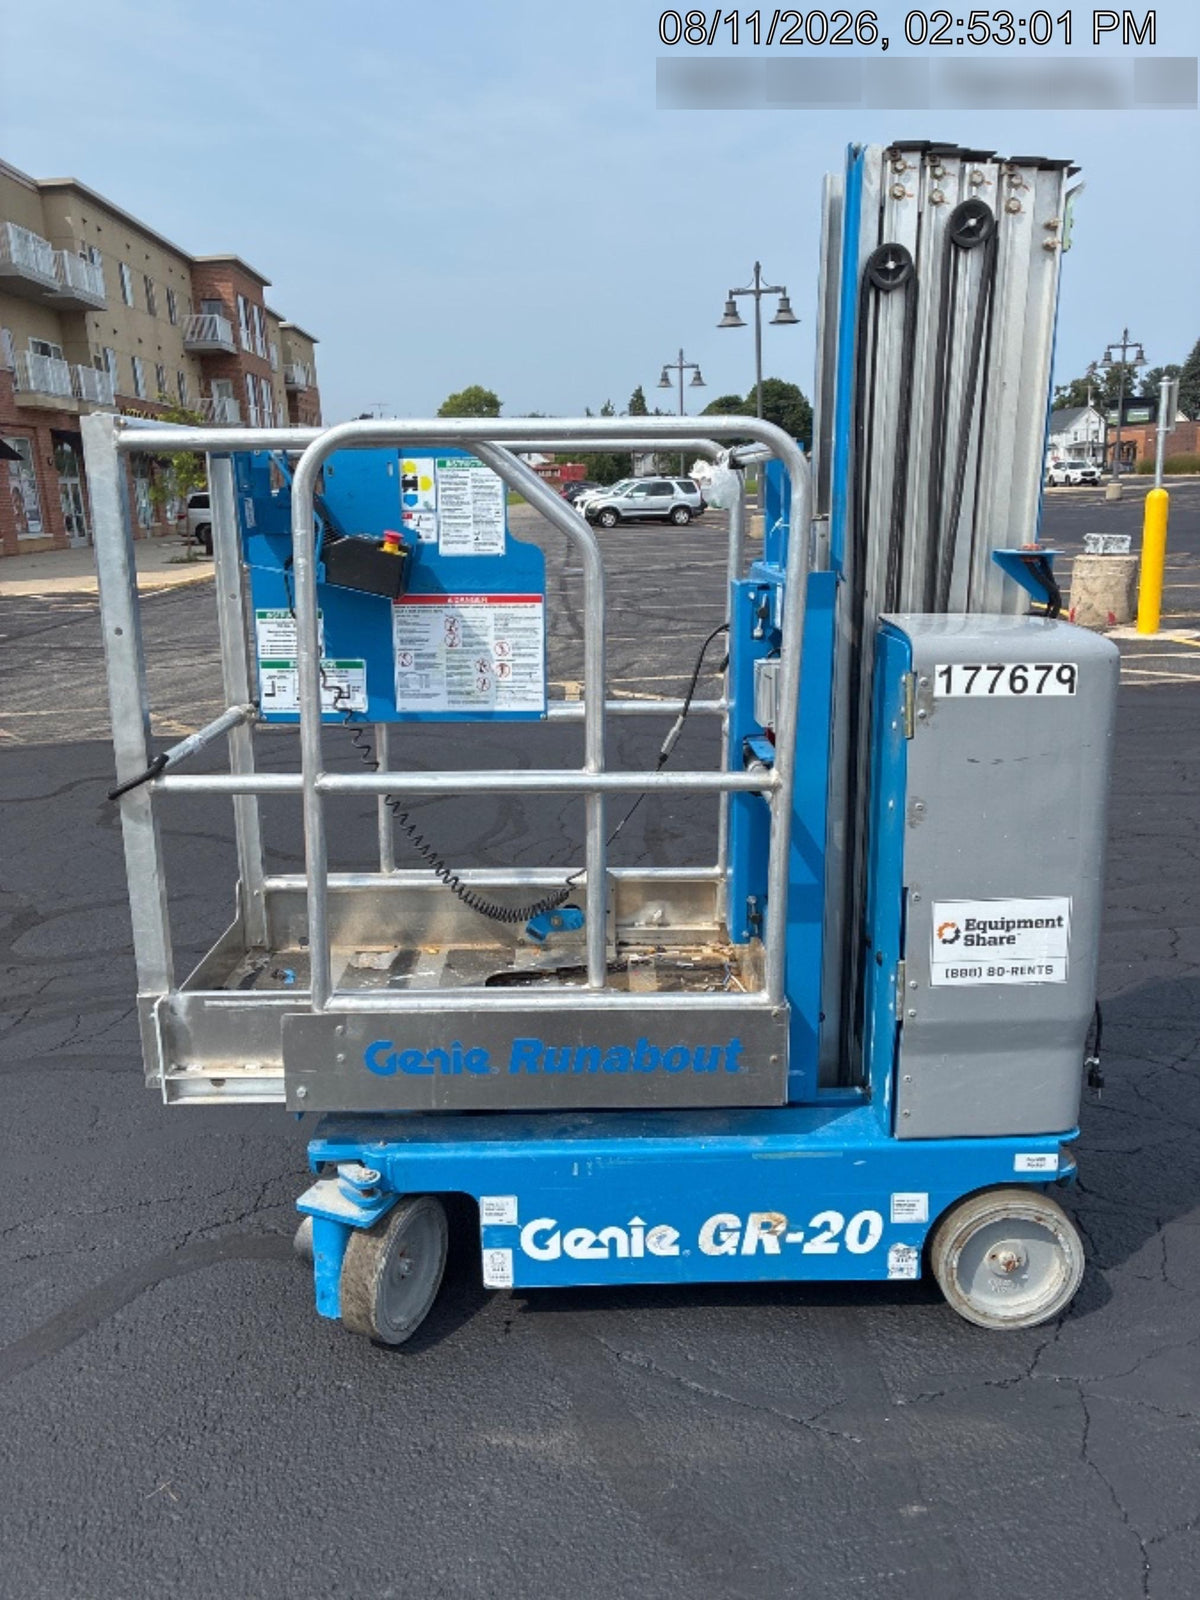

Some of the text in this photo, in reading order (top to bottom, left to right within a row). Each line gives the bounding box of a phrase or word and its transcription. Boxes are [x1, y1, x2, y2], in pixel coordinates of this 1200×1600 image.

[938, 664, 1077, 694] 177679
[964, 915, 1064, 933] Equipment
[963, 933, 1016, 947] Share
[364, 1037, 744, 1077] Genie Runabout
[520, 1215, 680, 1261] Genie
[698, 1210, 883, 1256] GR-20
